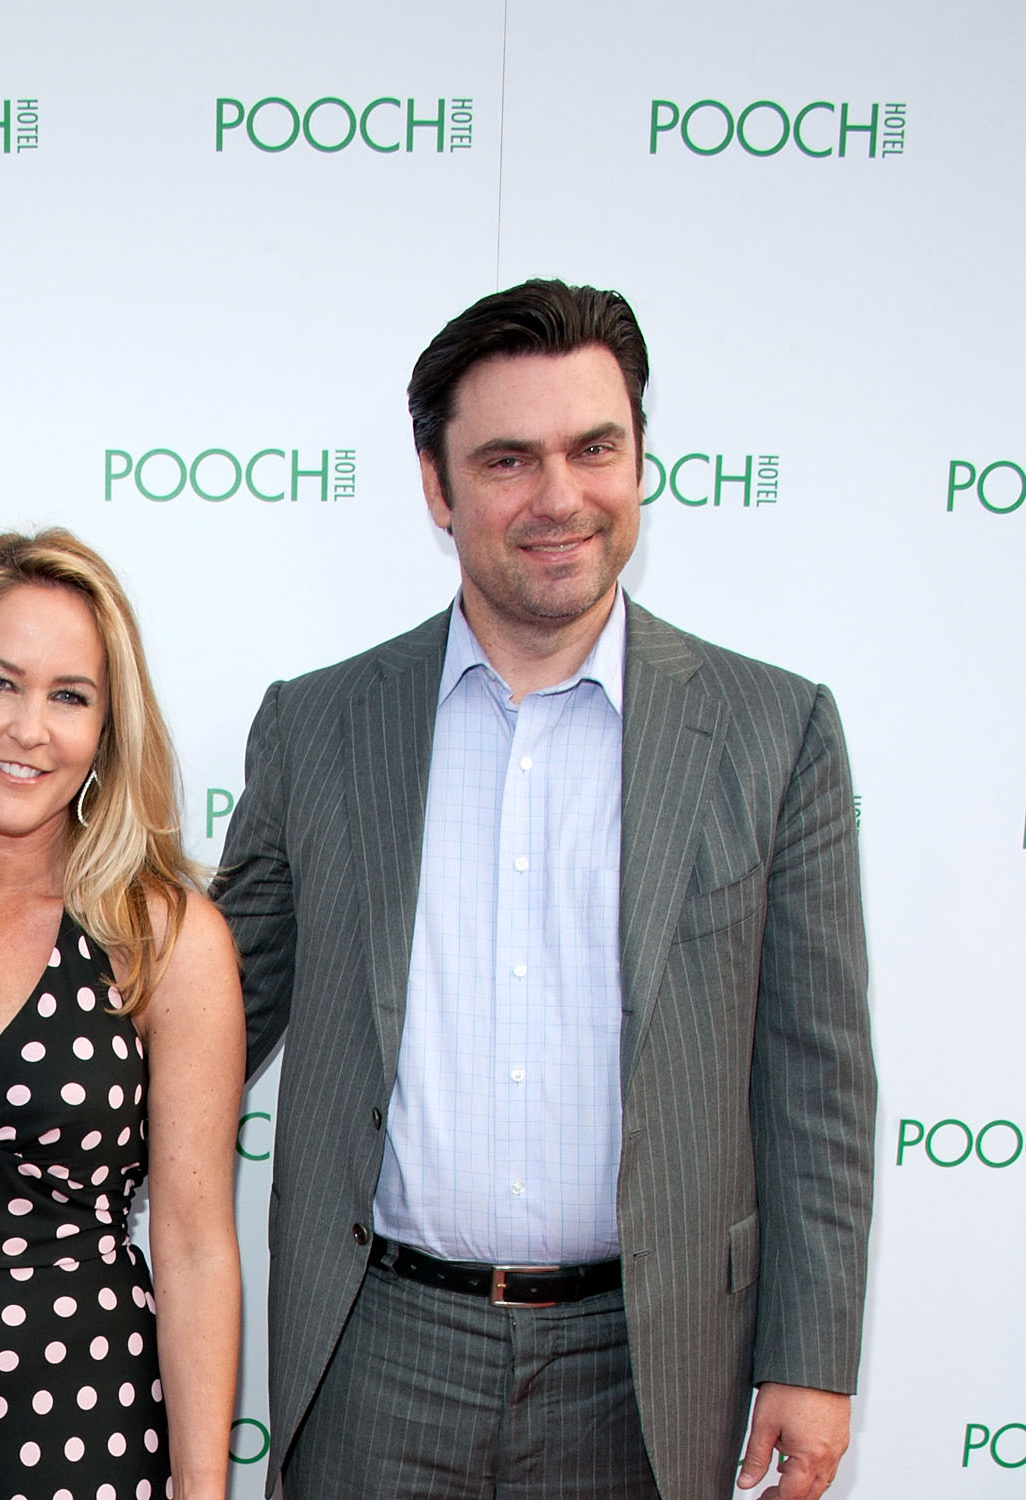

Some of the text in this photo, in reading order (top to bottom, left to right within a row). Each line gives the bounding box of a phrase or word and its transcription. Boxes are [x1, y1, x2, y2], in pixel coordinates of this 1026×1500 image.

[17, 99, 38, 152] HOTEL
[216, 97, 473, 152] POOCH HOTEL
[650, 100, 906, 158] POOCH HOTEL
[105, 448, 355, 502] POOCH HOTEL
[757, 455, 779, 507] HOTEL
